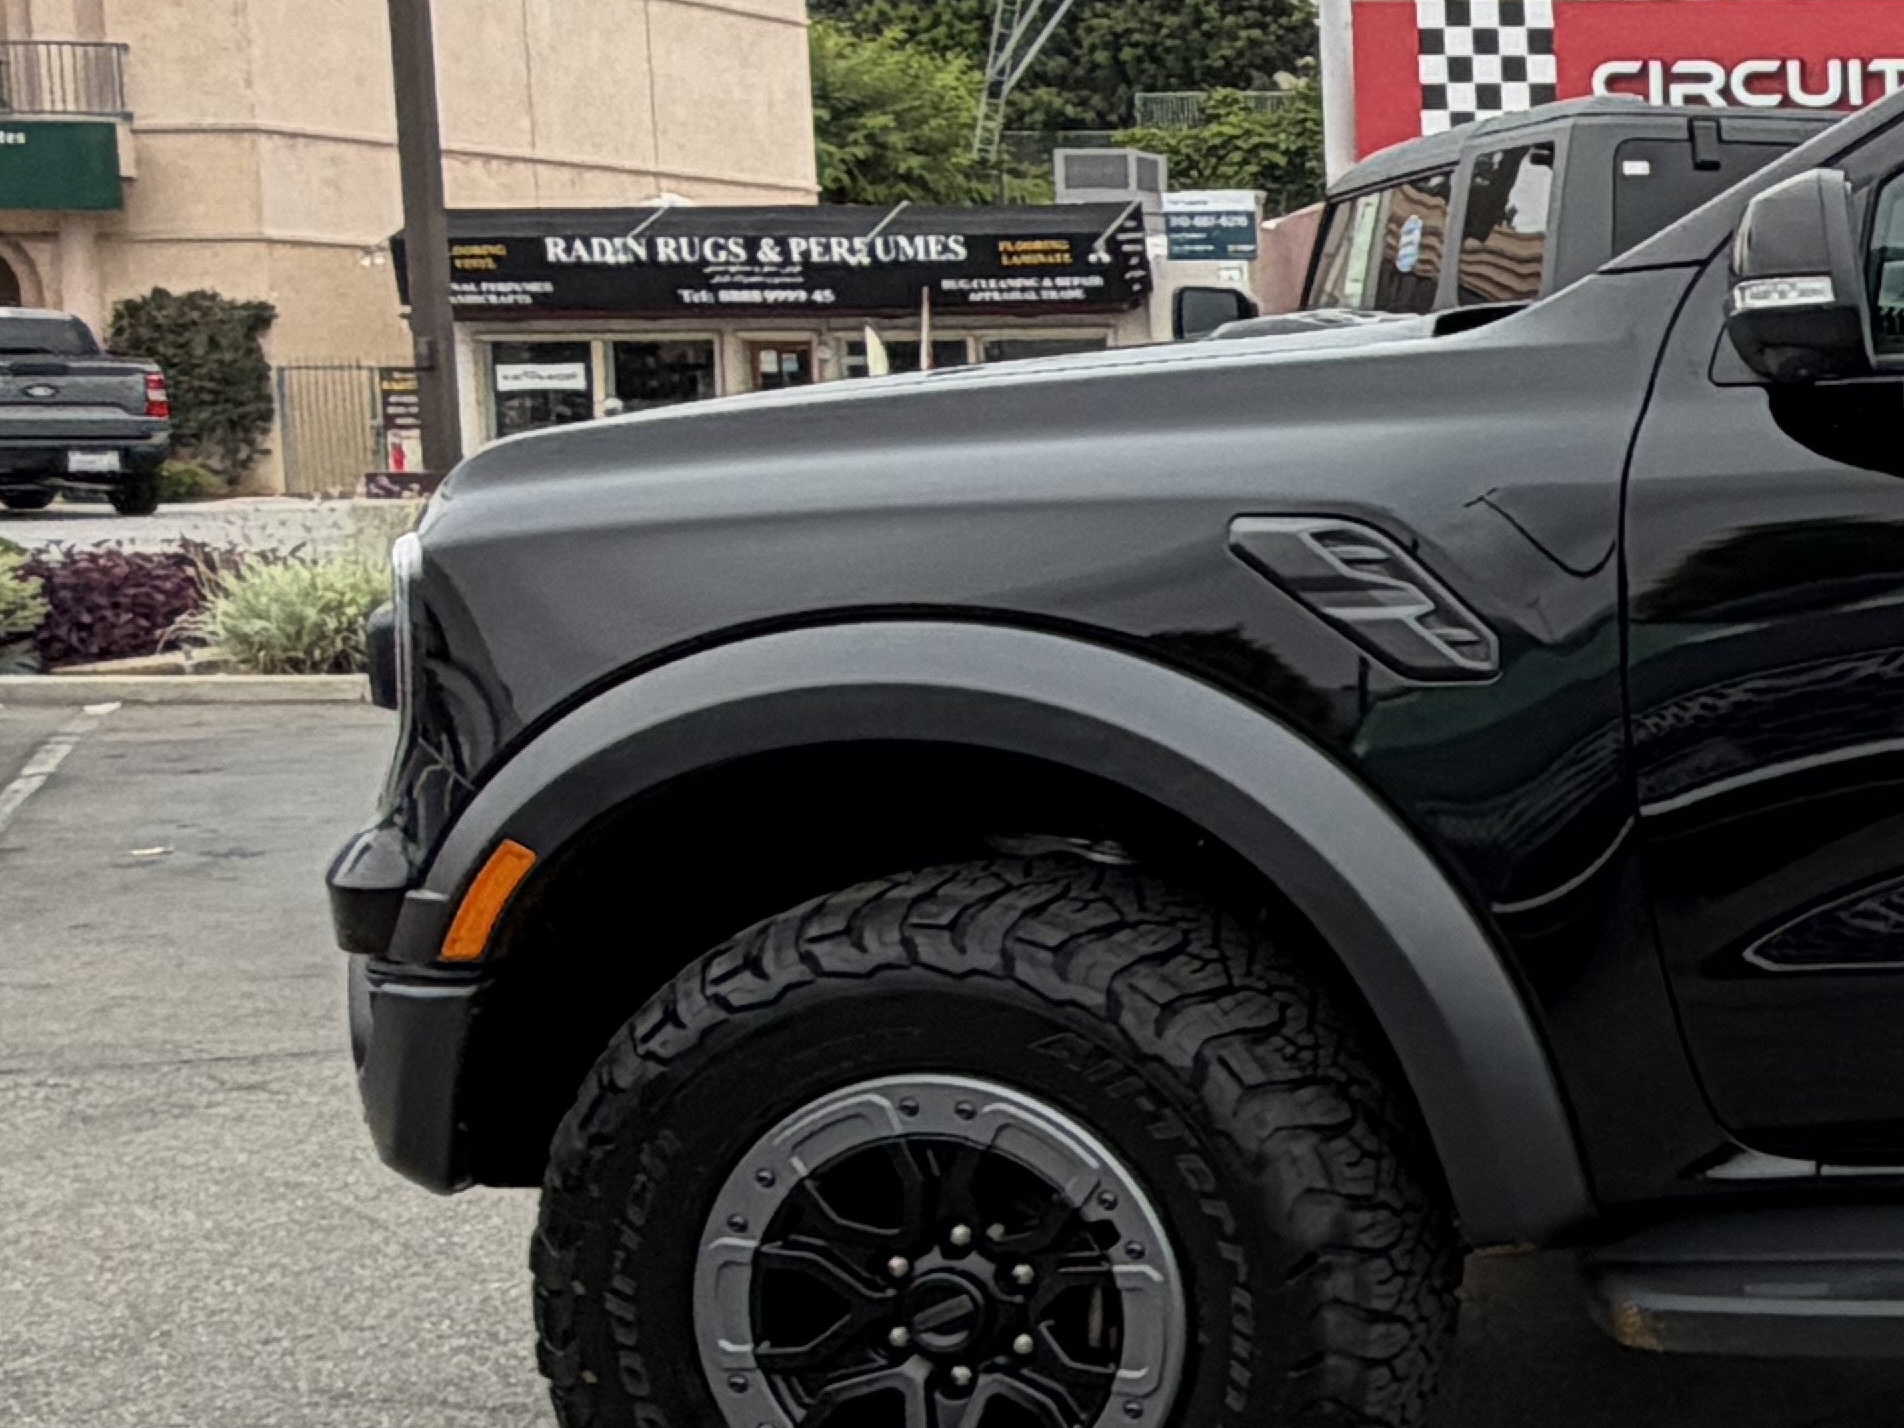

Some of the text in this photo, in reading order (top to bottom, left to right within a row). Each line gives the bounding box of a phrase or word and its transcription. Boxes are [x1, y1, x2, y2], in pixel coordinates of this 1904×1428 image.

[656, 235, 746, 263] RUGS
[756, 236, 783, 263] &
[788, 234, 968, 266] PERFUMES
